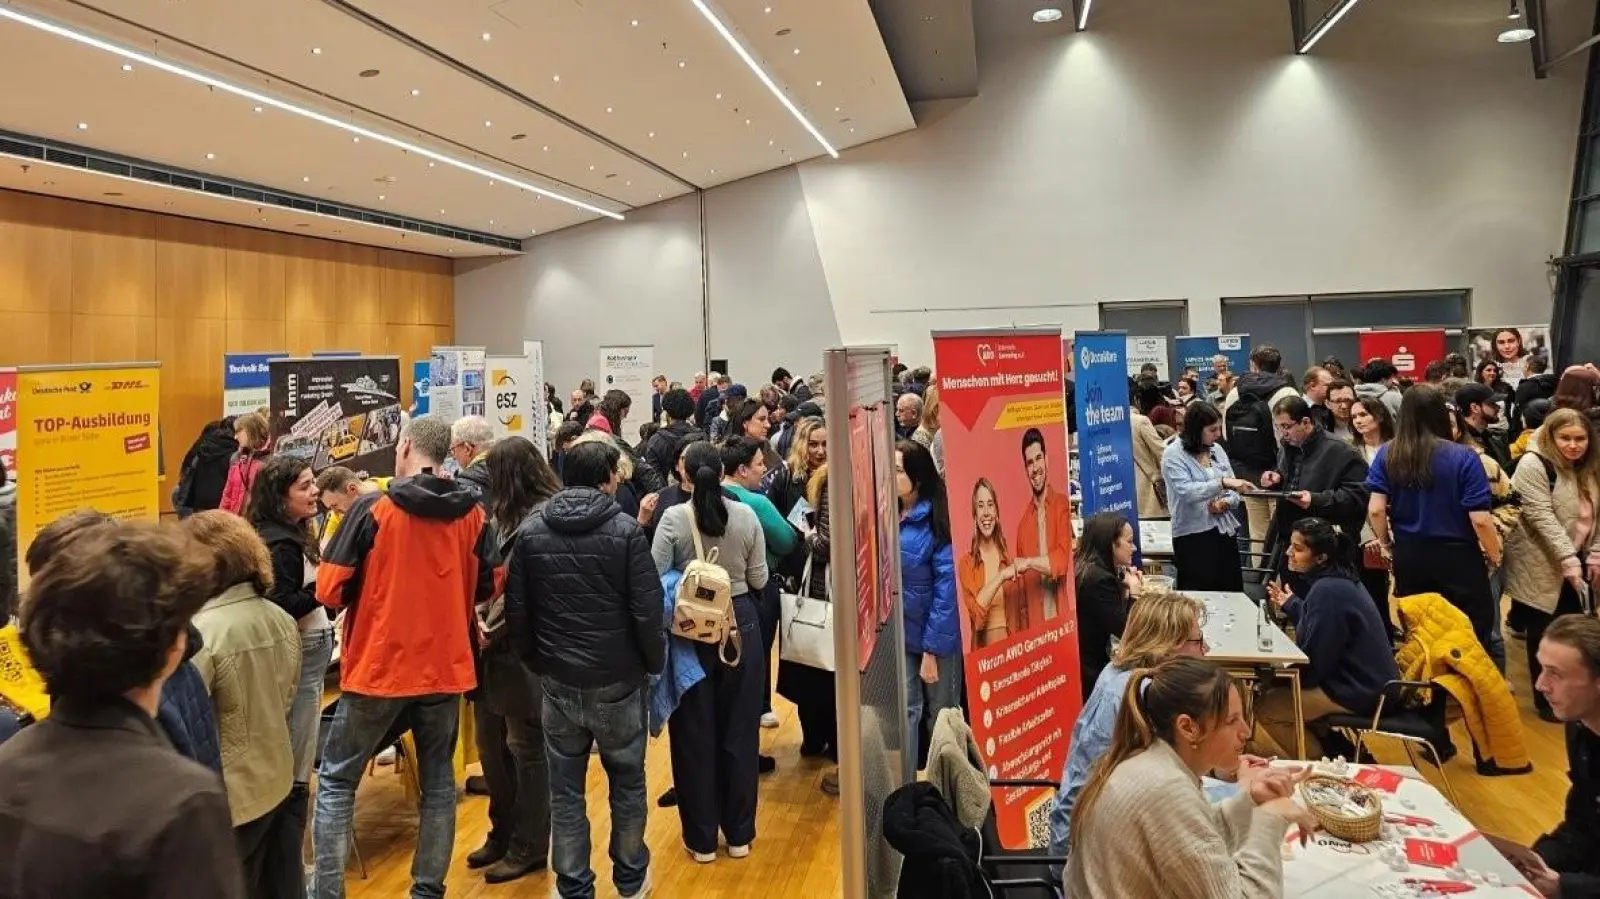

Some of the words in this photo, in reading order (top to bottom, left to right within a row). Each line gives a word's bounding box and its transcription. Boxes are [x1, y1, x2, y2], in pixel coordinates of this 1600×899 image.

[1090, 351, 1118, 363] DocuWare
[229, 364, 256, 373] Technik
[111, 380, 144, 390] DHL
[943, 374, 989, 390] Menschen
[990, 372, 1004, 386] mit
[1005, 372, 1023, 383] Herz
[1024, 369, 1058, 387] gesucht!
[32, 387, 62, 395] Deutsche
[63, 385, 78, 393] Post
[496, 391, 518, 409] esz
[34, 413, 150, 433] TOP-Ausbildung
[1086, 404, 1100, 425] the
[1101, 404, 1124, 424] team
[979, 654, 1003, 673] Warum
[1005, 643, 1023, 662] AWO
[1024, 631, 1058, 653] Germering
